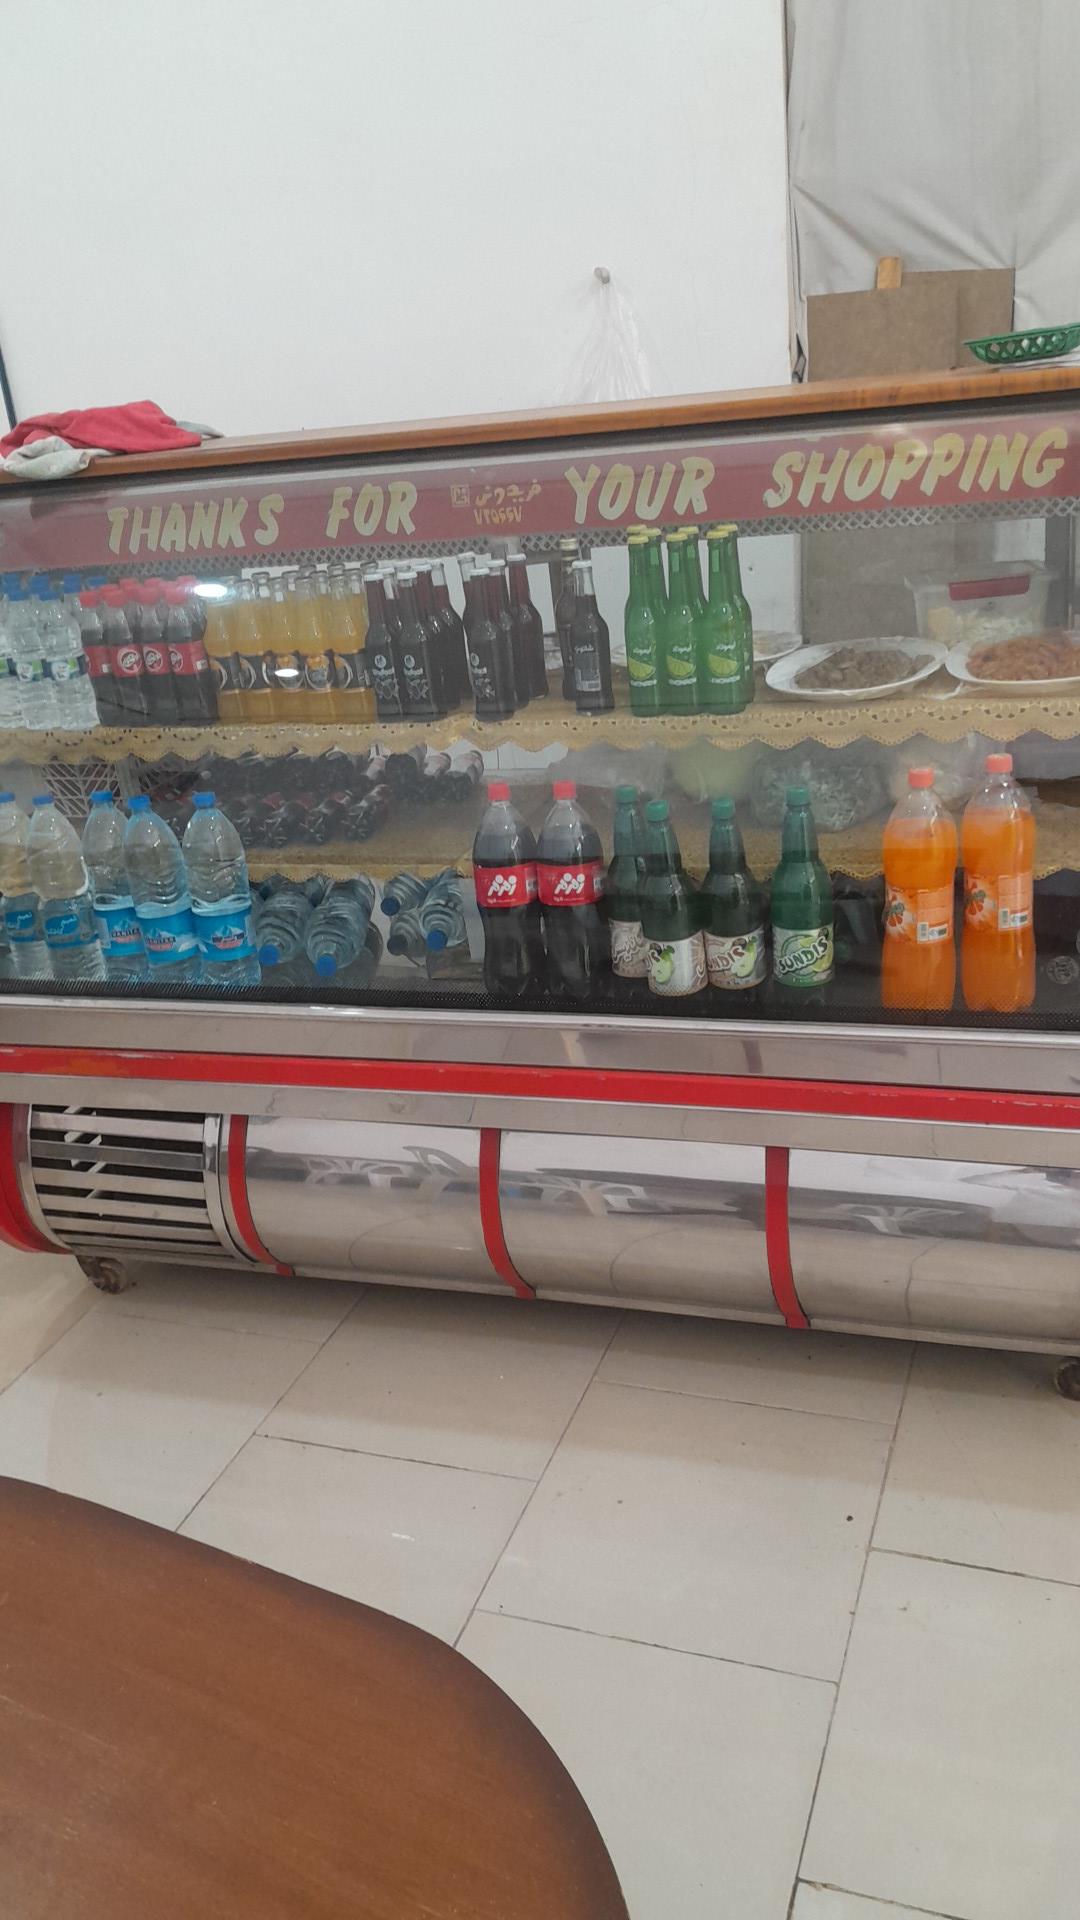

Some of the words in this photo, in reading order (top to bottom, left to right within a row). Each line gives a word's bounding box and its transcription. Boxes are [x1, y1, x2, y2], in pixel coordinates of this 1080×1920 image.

[108, 493, 284, 554] THANKS
[326, 481, 417, 539] FOR
[564, 456, 715, 524] YOUR
[764, 427, 1068, 509] SHOPPING
[778, 936, 829, 974] SUNDIS
